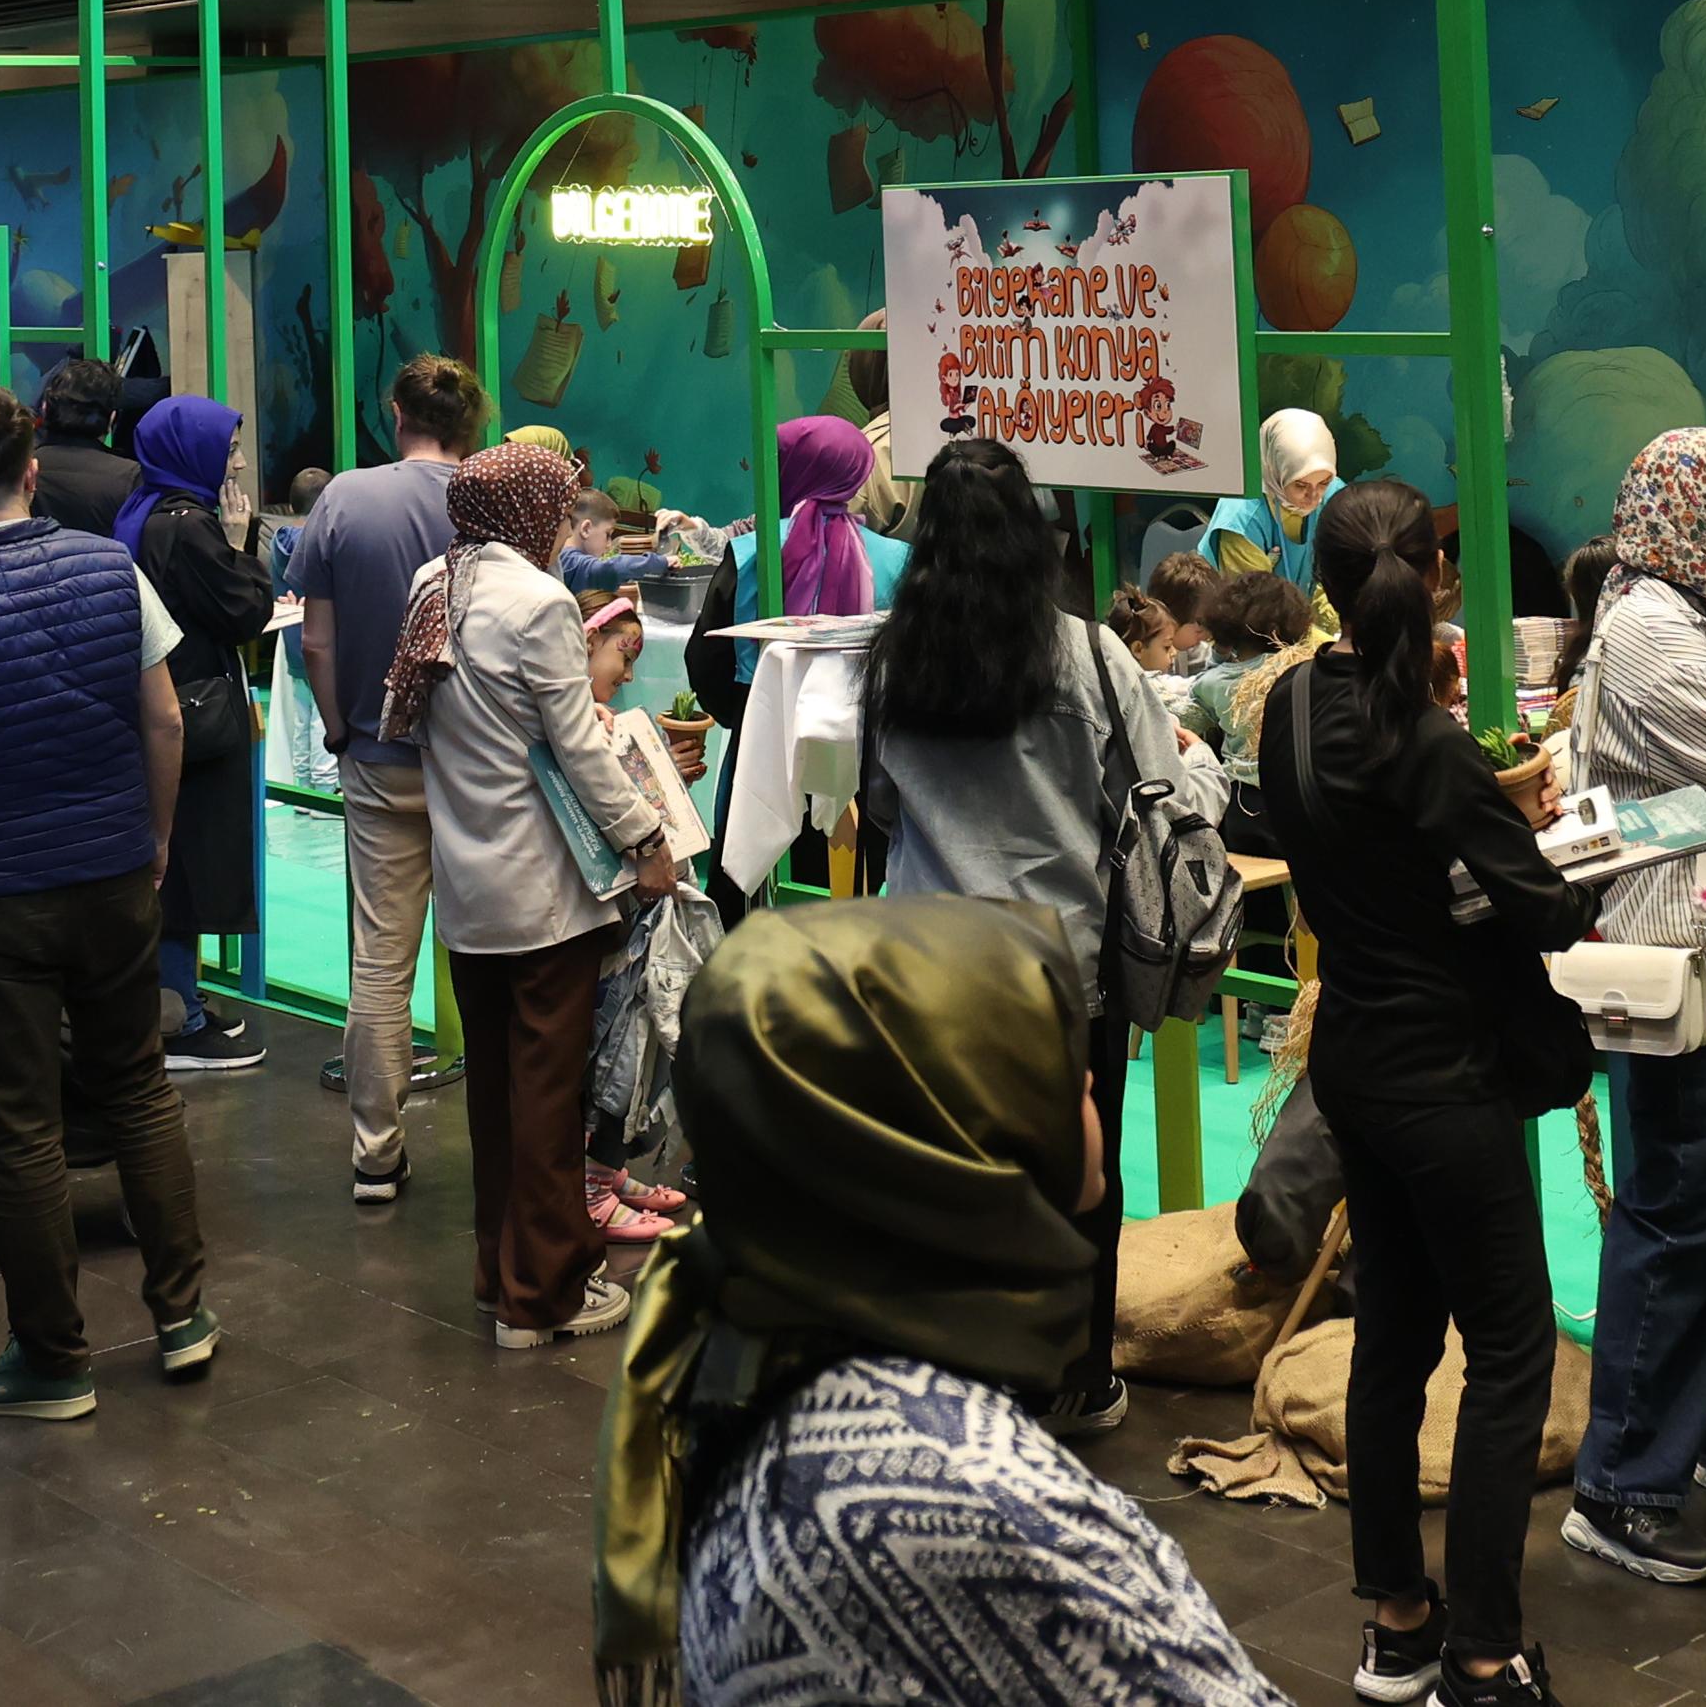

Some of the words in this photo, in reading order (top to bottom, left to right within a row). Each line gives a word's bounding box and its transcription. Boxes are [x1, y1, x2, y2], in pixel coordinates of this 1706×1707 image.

[959, 324, 1048, 380] Bilim
[1055, 325, 1159, 381] Konya
[977, 379, 1145, 448] Atölyeleri
